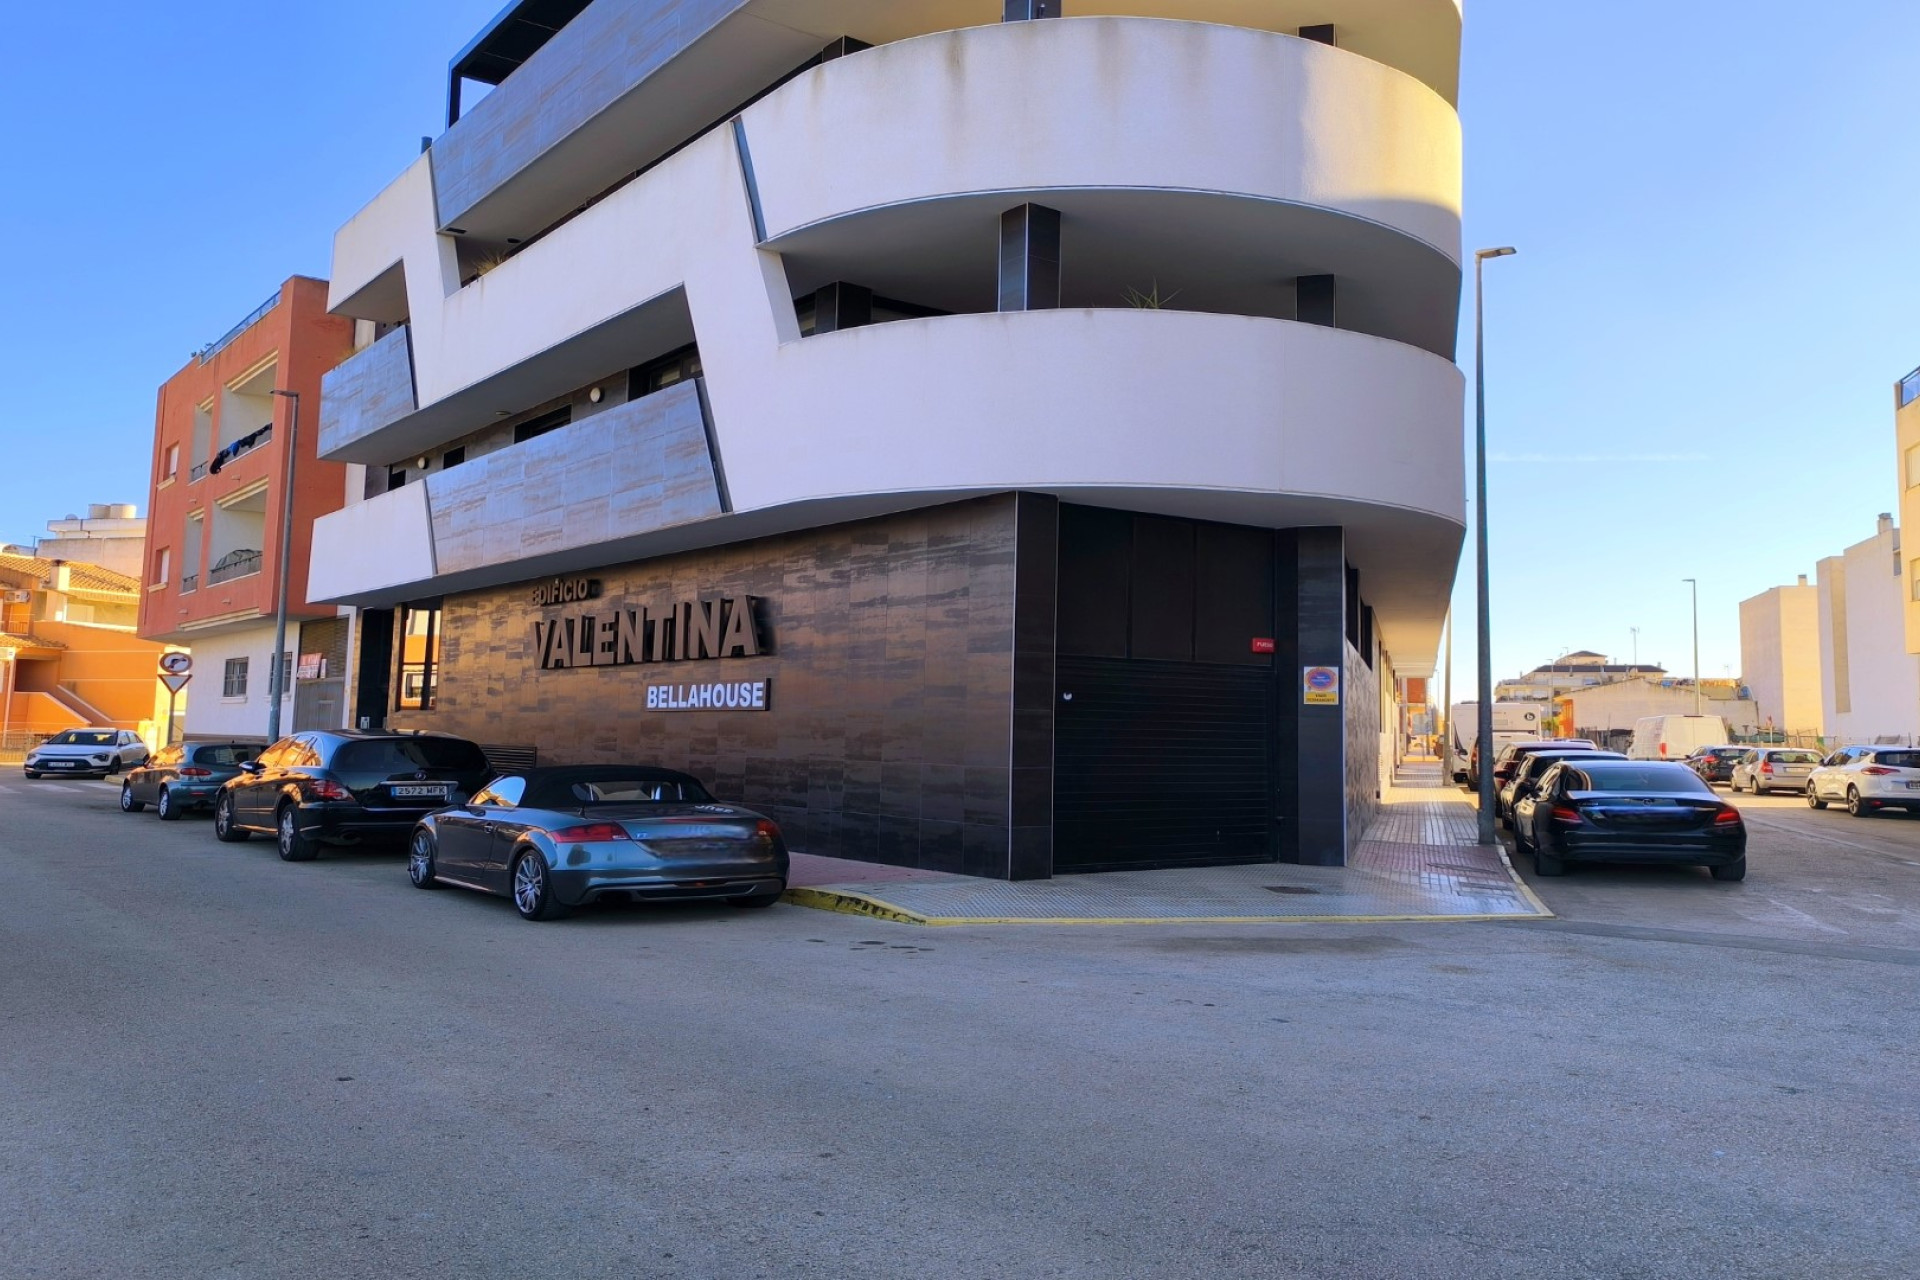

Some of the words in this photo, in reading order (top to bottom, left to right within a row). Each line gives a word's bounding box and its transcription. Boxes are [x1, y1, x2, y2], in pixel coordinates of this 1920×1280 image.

[533, 579, 587, 605] EDIFICIO
[531, 595, 760, 669] VALENTINA
[646, 682, 764, 709] BELLAHOUSE
[398, 786, 424, 795] 2572
